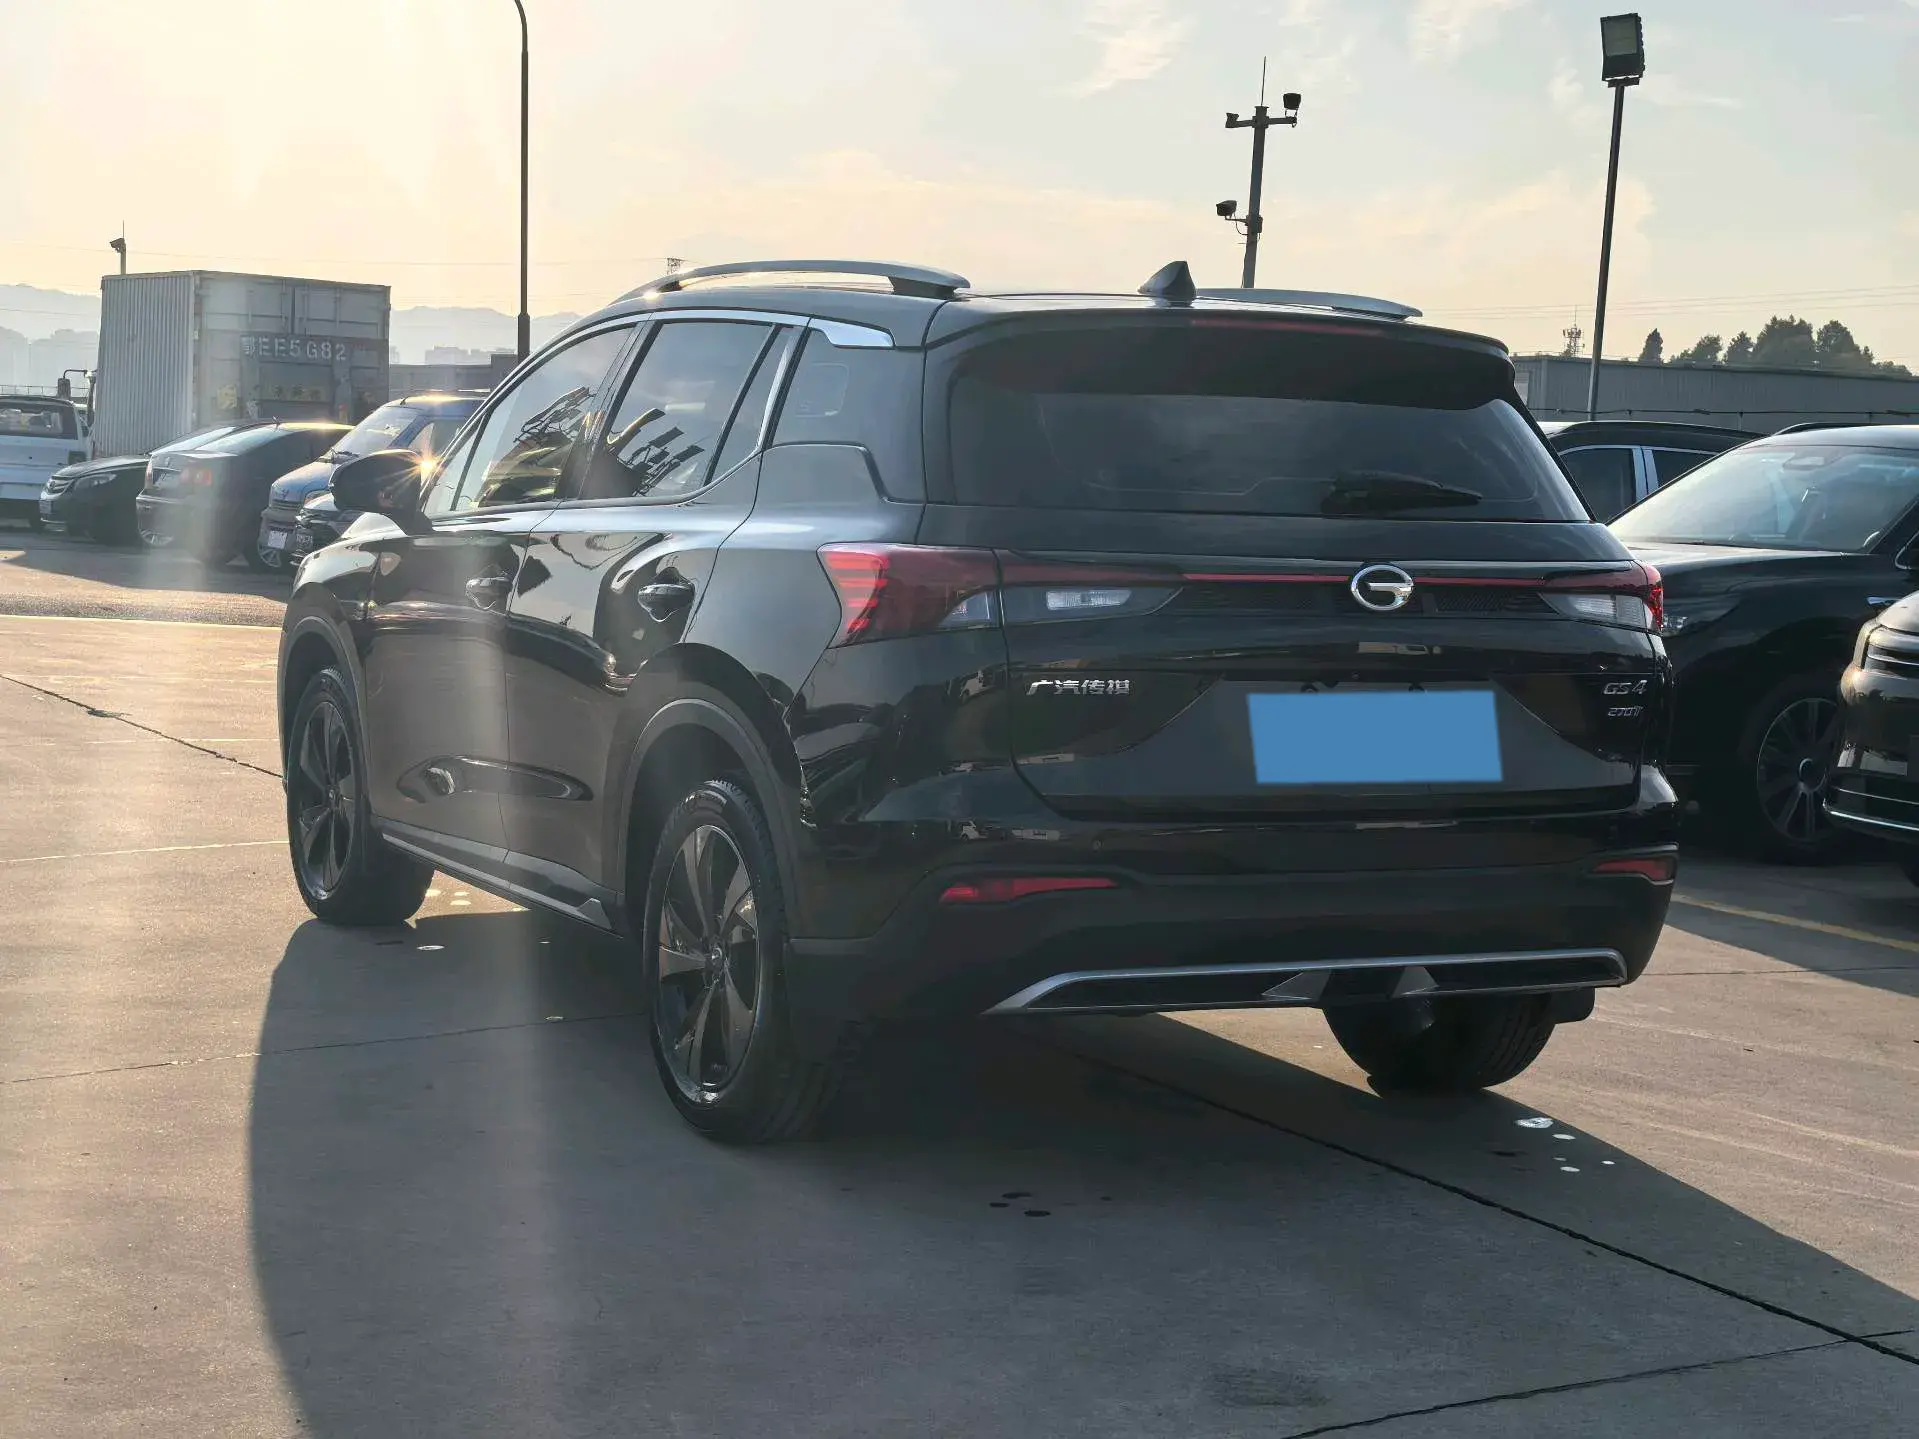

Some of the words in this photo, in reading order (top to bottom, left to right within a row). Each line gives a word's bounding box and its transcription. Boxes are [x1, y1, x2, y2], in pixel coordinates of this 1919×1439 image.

[1026, 679, 1130, 695] 广汽传祺
[1603, 679, 1648, 695] GS4
